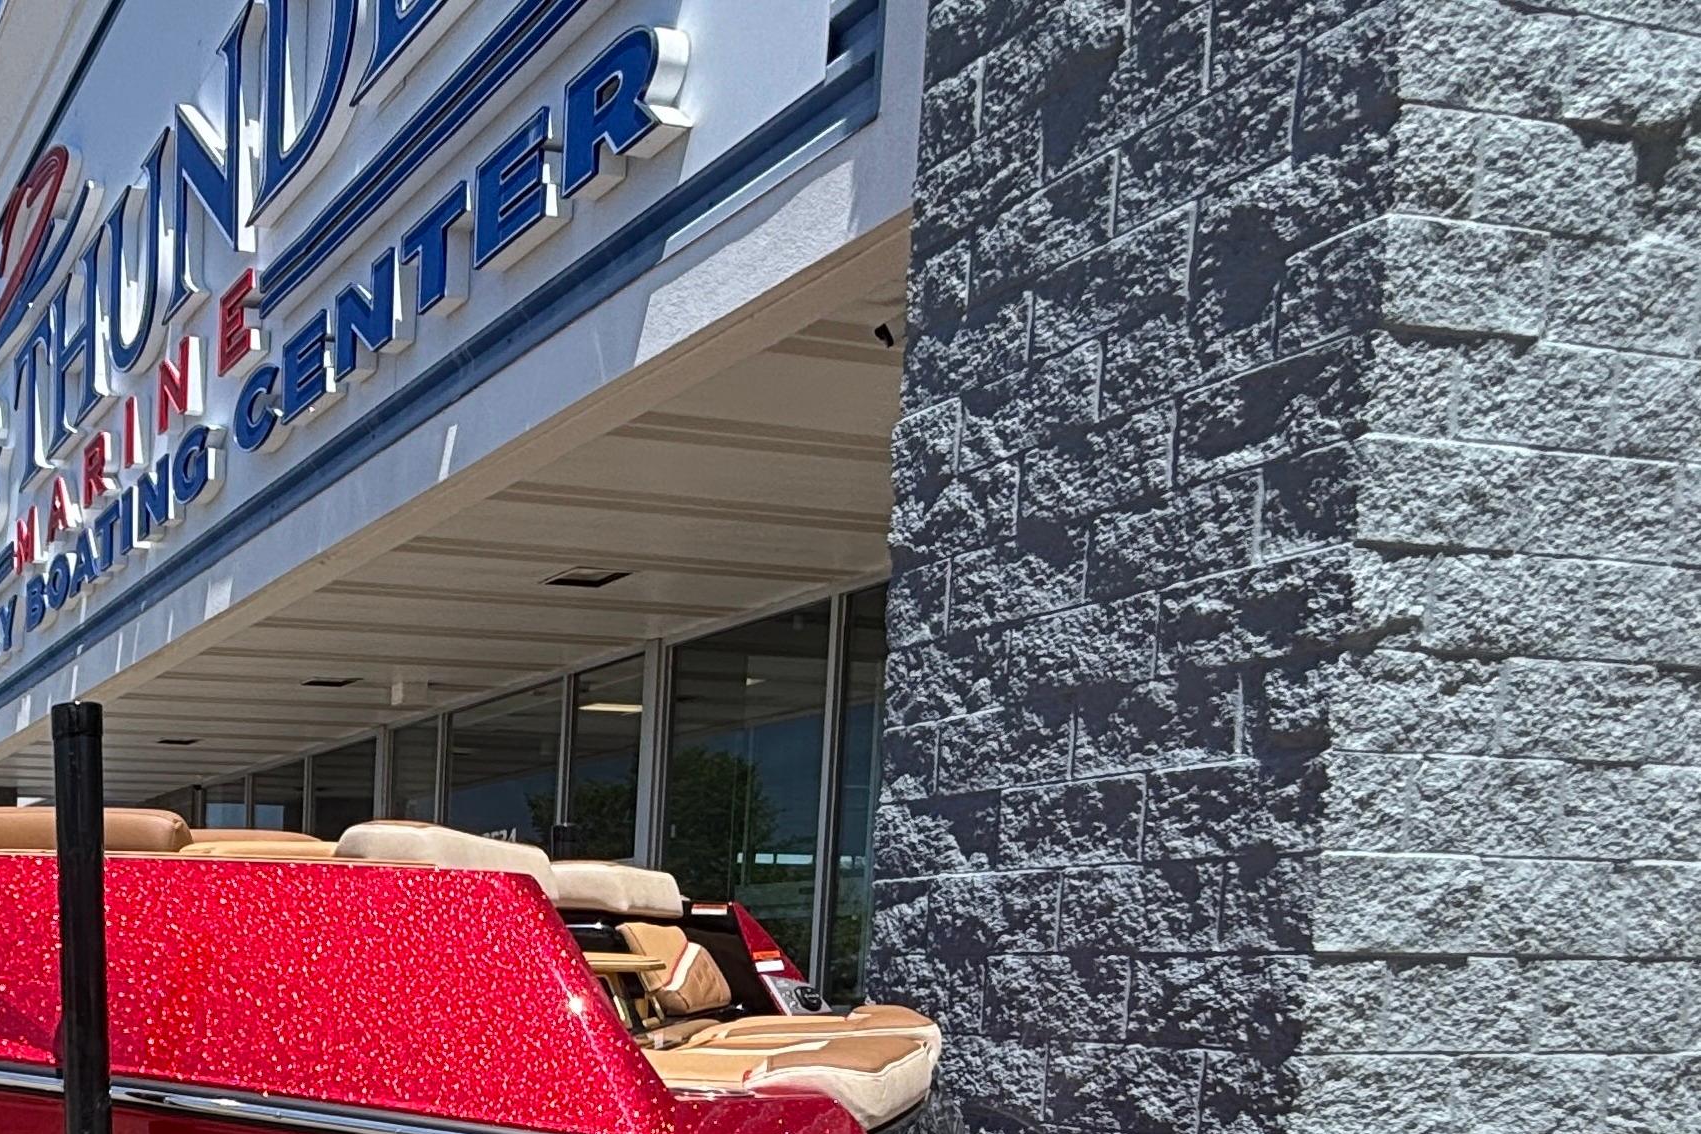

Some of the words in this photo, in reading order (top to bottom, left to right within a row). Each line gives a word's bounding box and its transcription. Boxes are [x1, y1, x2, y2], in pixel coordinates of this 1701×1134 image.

[12, 267, 256, 576] MARINE
[26, 424, 210, 633] BOATING
[232, 24, 662, 454] CENTER
